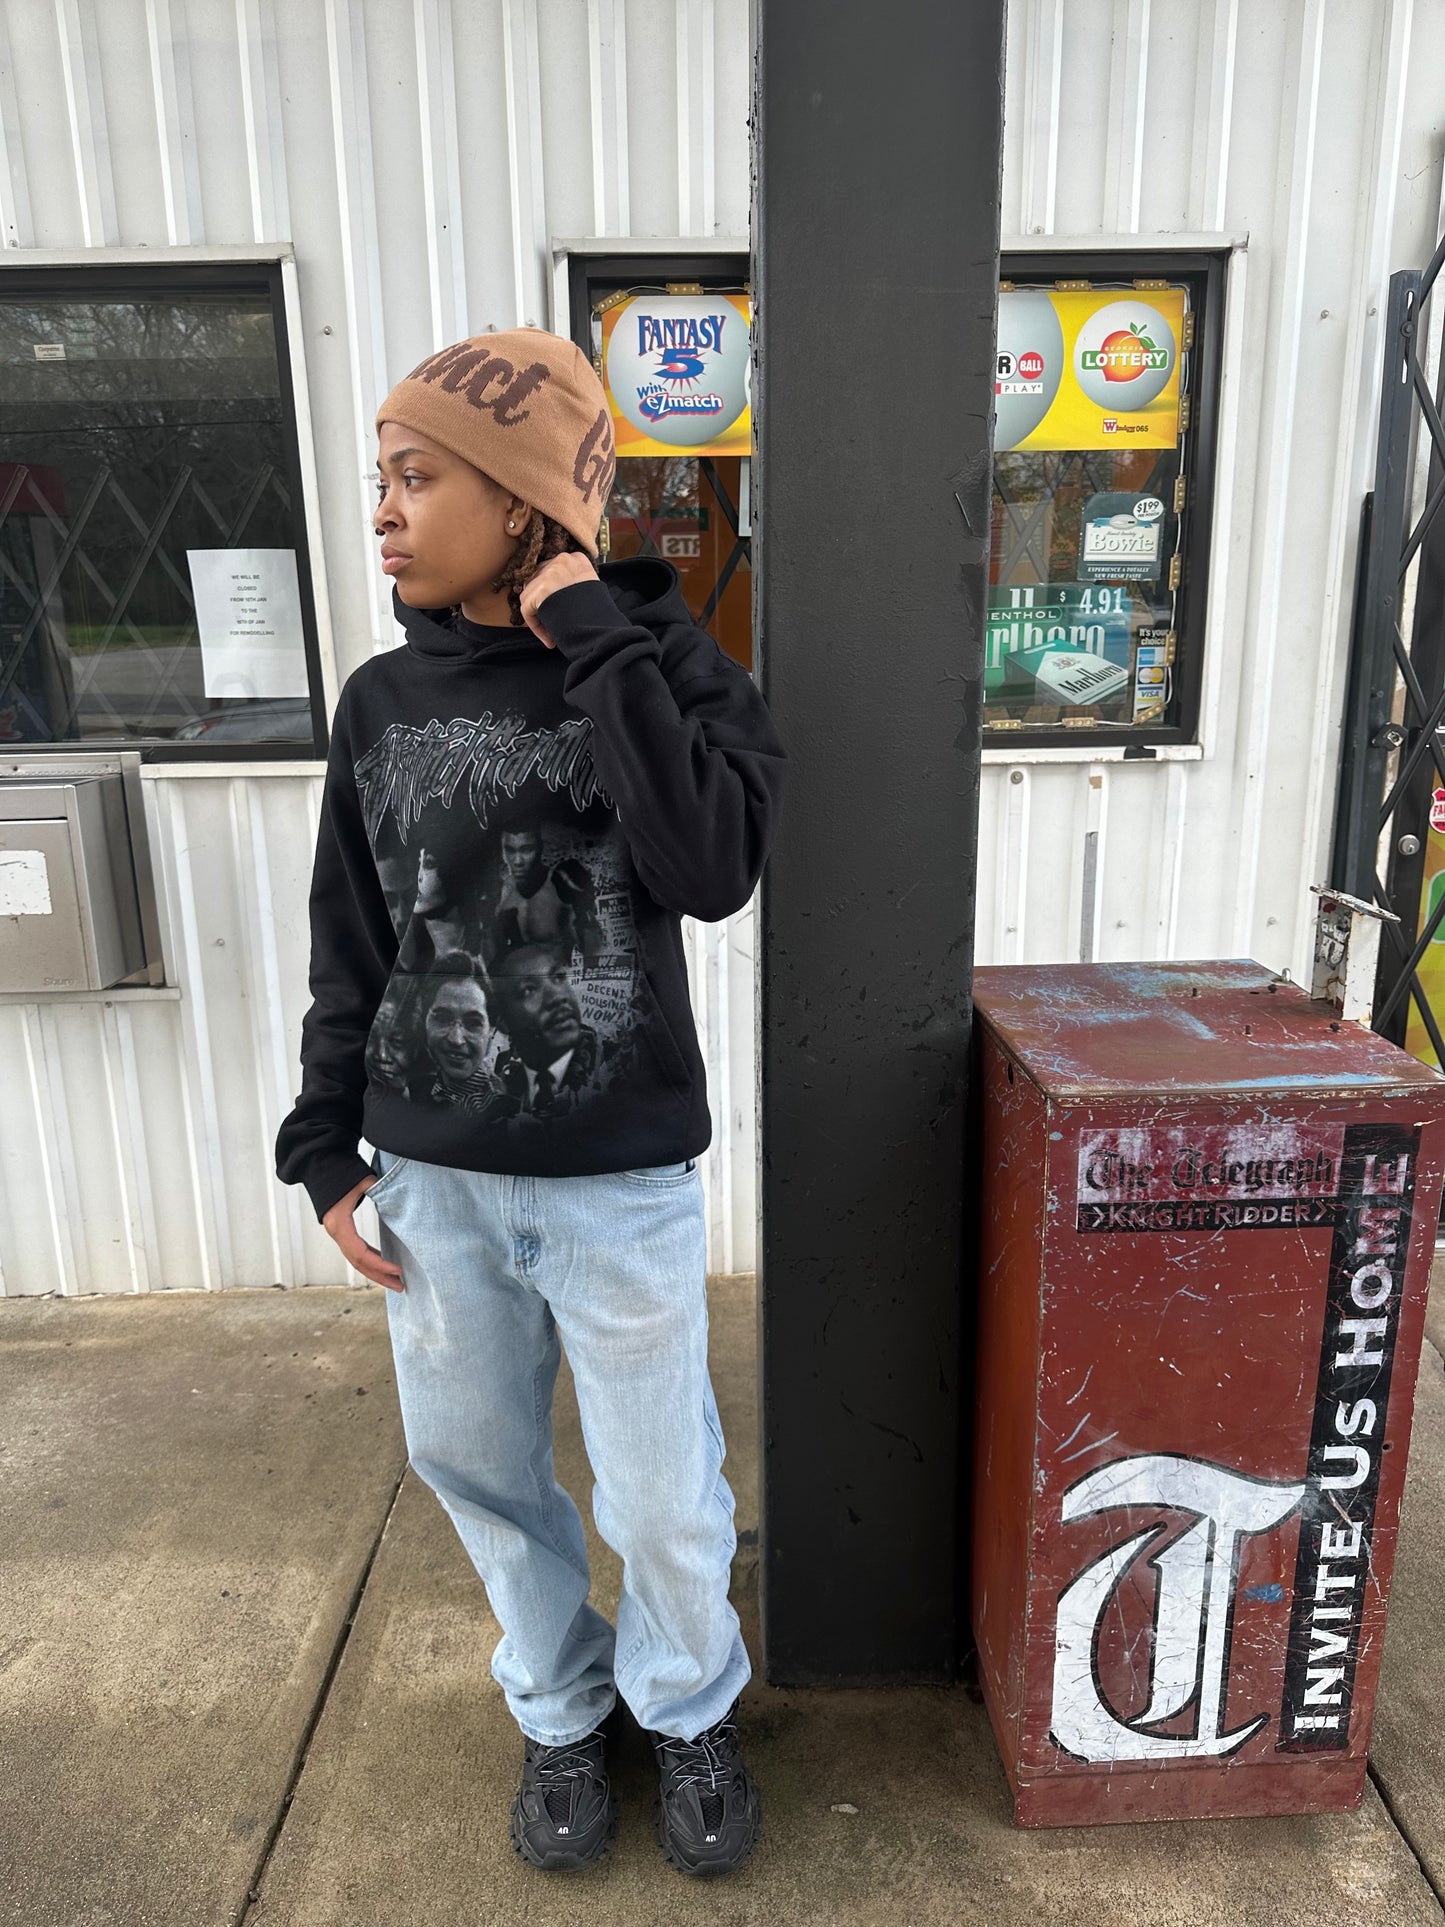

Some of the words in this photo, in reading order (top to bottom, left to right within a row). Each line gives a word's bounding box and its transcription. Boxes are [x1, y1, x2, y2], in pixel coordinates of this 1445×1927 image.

[637, 315, 727, 357] FANTASY
[652, 347, 705, 381] 5
[1019, 359, 1042, 372] BALL
[1085, 352, 1166, 369] LOTTERY
[636, 382, 668, 400] With
[1090, 533, 1155, 552] Bowie
[1059, 591, 1067, 603] $
[1079, 587, 1124, 615] 4.91
[986, 610, 1057, 621] ENTHOL
[1139, 628, 1151, 637] It's
[1140, 637, 1166, 646] choice
[1057, 664, 1124, 696] Marlboro
[1141, 690, 1160, 698] VISA
[598, 955, 619, 968] WE
[584, 966, 632, 980] DEMAND
[587, 983, 626, 999] DECENT
[581, 994, 627, 1011] HOUSING
[582, 1007, 622, 1025] NOW!
[1086, 1149, 1155, 1192] The
[1170, 1147, 1338, 1193] Telegraph
[1335, 1153, 1410, 1368] HOME
[1319, 1398, 1378, 1491] US
[1293, 1522, 1364, 1731] INVITE
